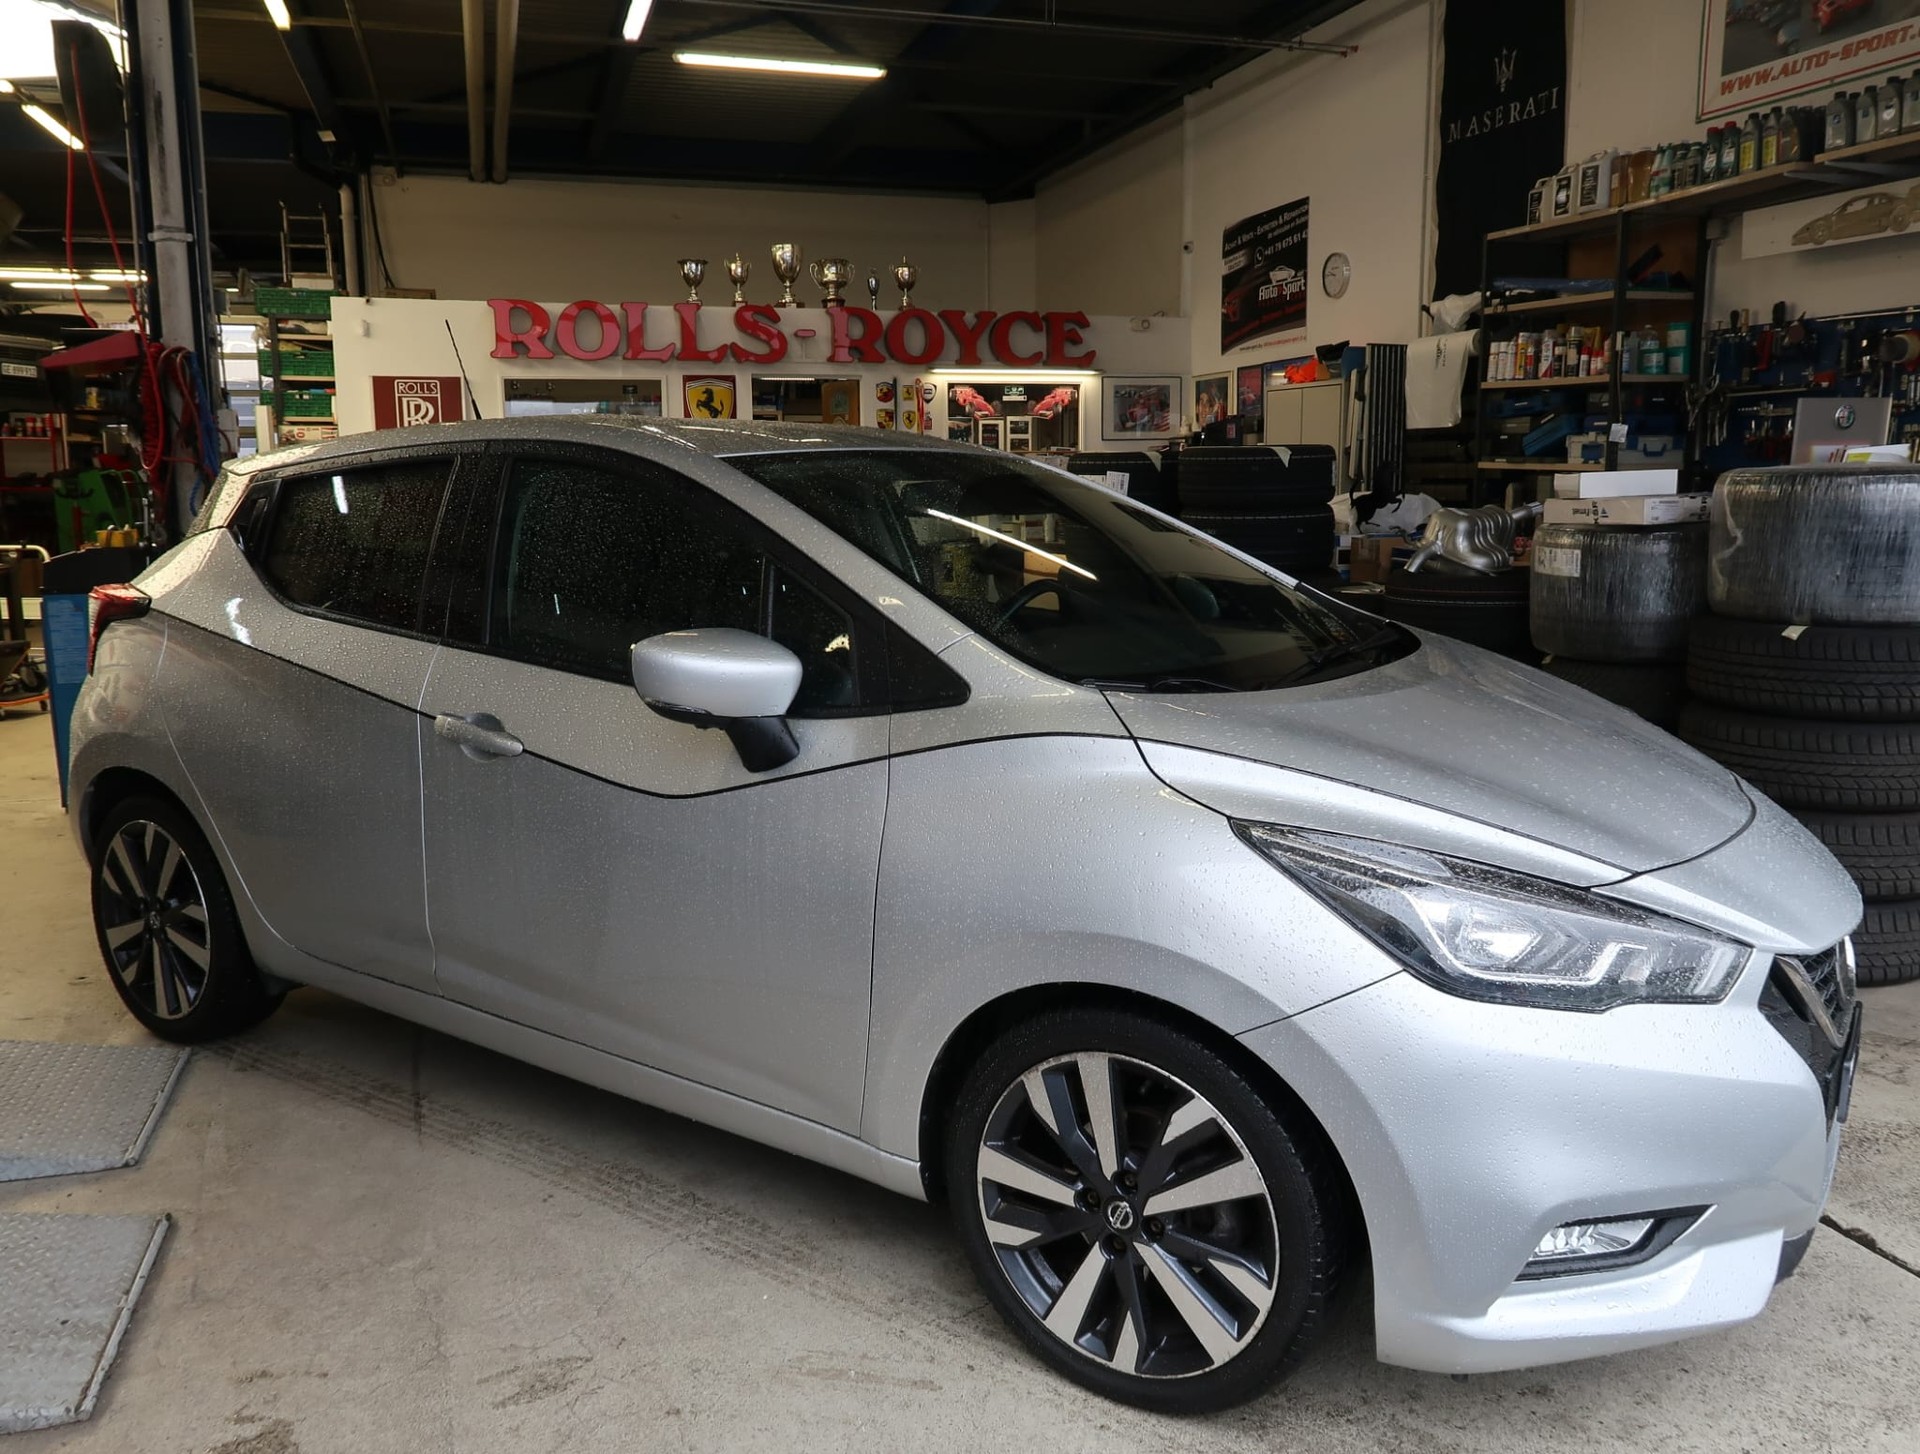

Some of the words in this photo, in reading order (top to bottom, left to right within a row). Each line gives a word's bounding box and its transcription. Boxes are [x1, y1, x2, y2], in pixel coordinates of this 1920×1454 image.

[1720, 23, 1920, 96] WWW.AUTO-SPORT.
[1447, 87, 1560, 144] MASERATI
[1259, 285, 1278, 300] Auto
[1282, 278, 1306, 300] Sport
[397, 382, 437, 394] ROLLS
